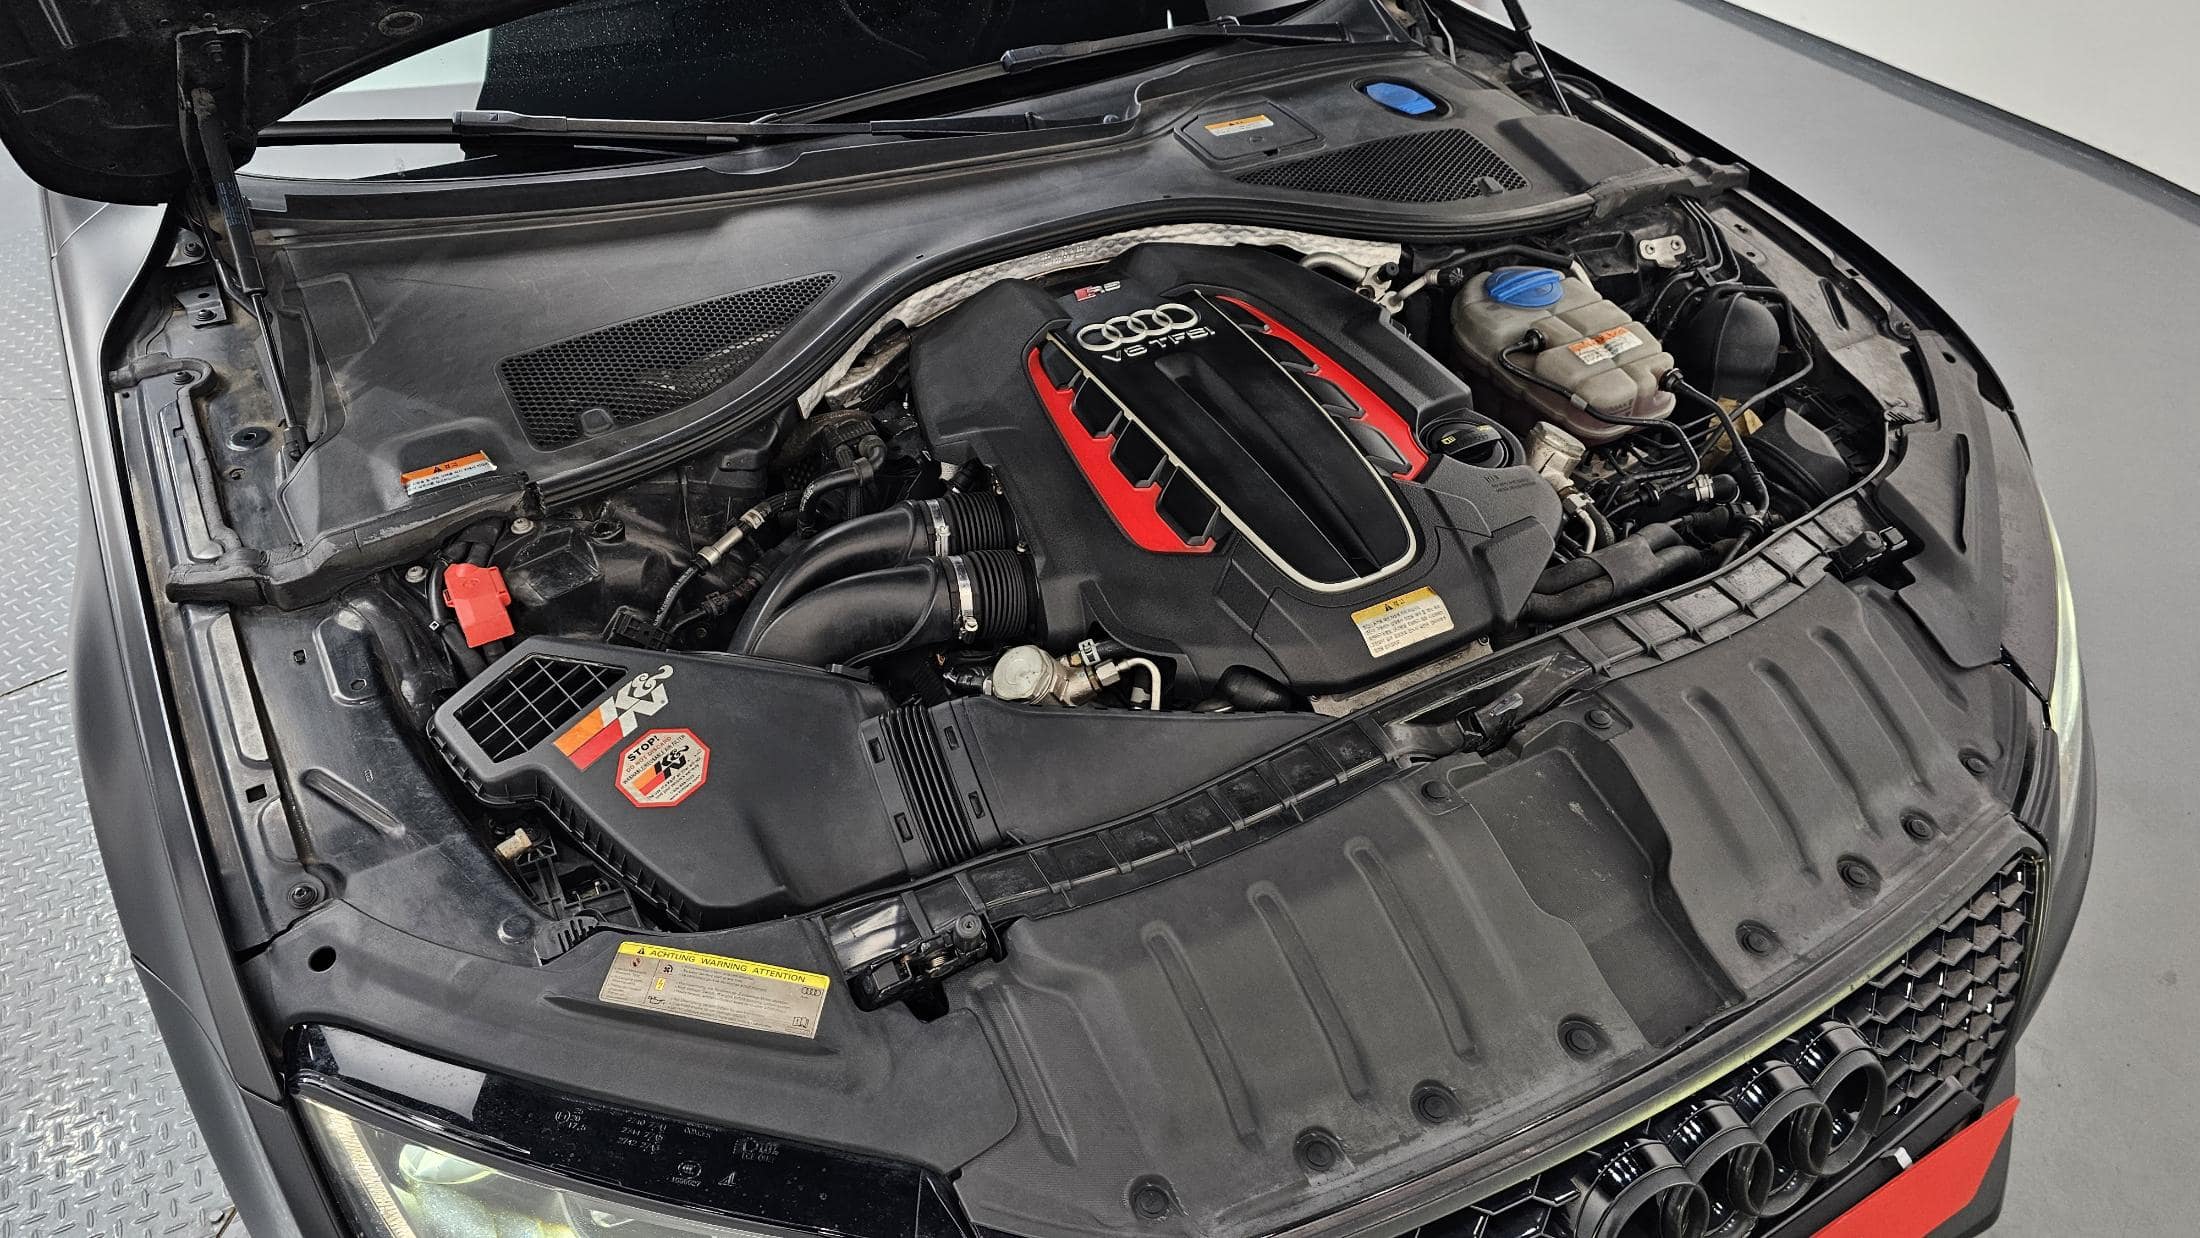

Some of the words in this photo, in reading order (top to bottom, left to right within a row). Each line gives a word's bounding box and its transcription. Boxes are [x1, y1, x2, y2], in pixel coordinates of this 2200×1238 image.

[1148, 326, 1216, 349] TFSI
[600, 664, 674, 738] K&N
[627, 735, 660, 762] STOP!
[654, 746, 689, 779] K&N
[625, 764, 635, 773] DO
[649, 949, 696, 963] ACHTUNG
[701, 958, 747, 972] WARNING
[752, 967, 806, 983] ATTENTION
